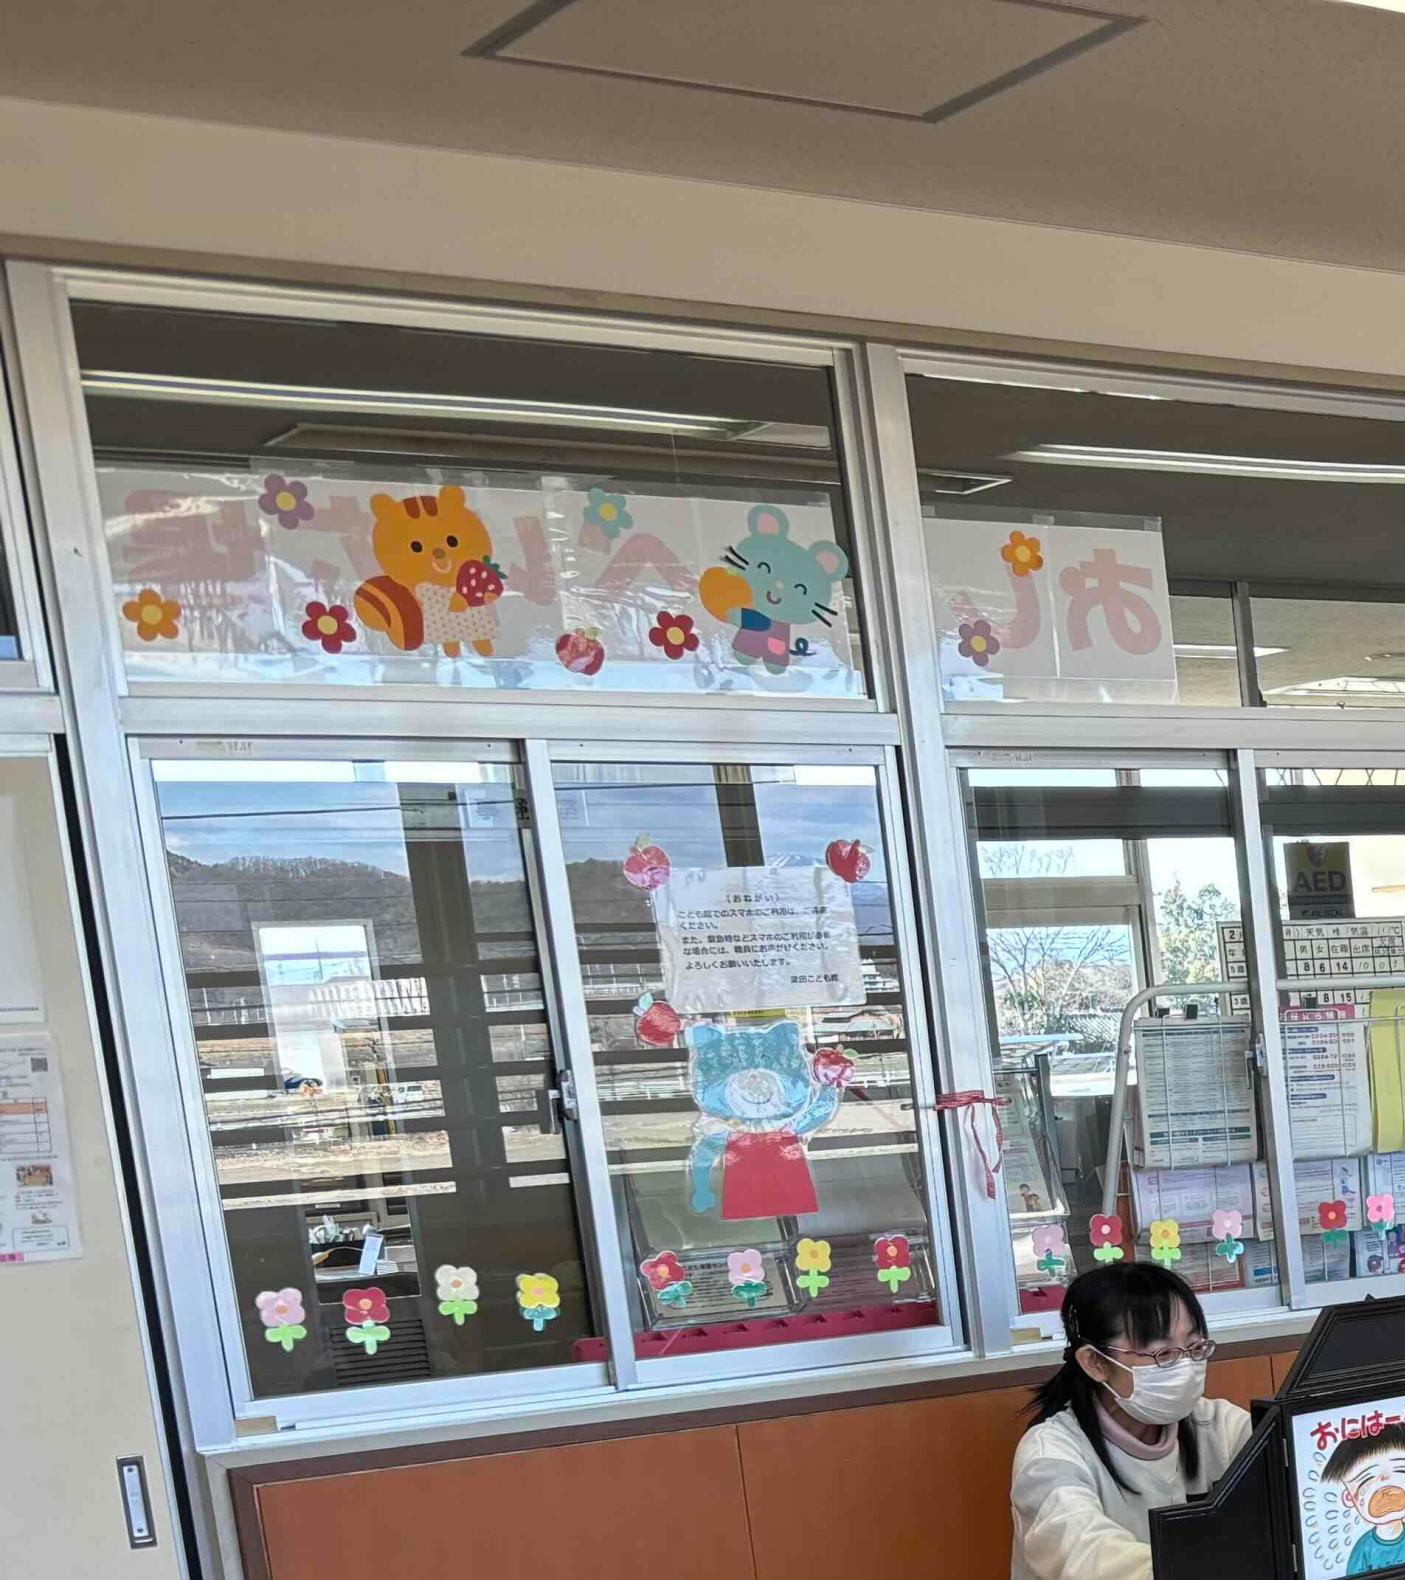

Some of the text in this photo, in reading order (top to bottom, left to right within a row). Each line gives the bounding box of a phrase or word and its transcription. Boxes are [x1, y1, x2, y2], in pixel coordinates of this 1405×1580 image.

[1294, 871, 1346, 892] AED
[1316, 945, 1324, 954] 女
[1353, 944, 1371, 954] 出席
[1303, 962, 1310, 971] 8
[1319, 963, 1326, 972] 6
[1336, 961, 1348, 971] 14
[1323, 993, 1329, 1002] 8
[1341, 992, 1352, 1002] 15
